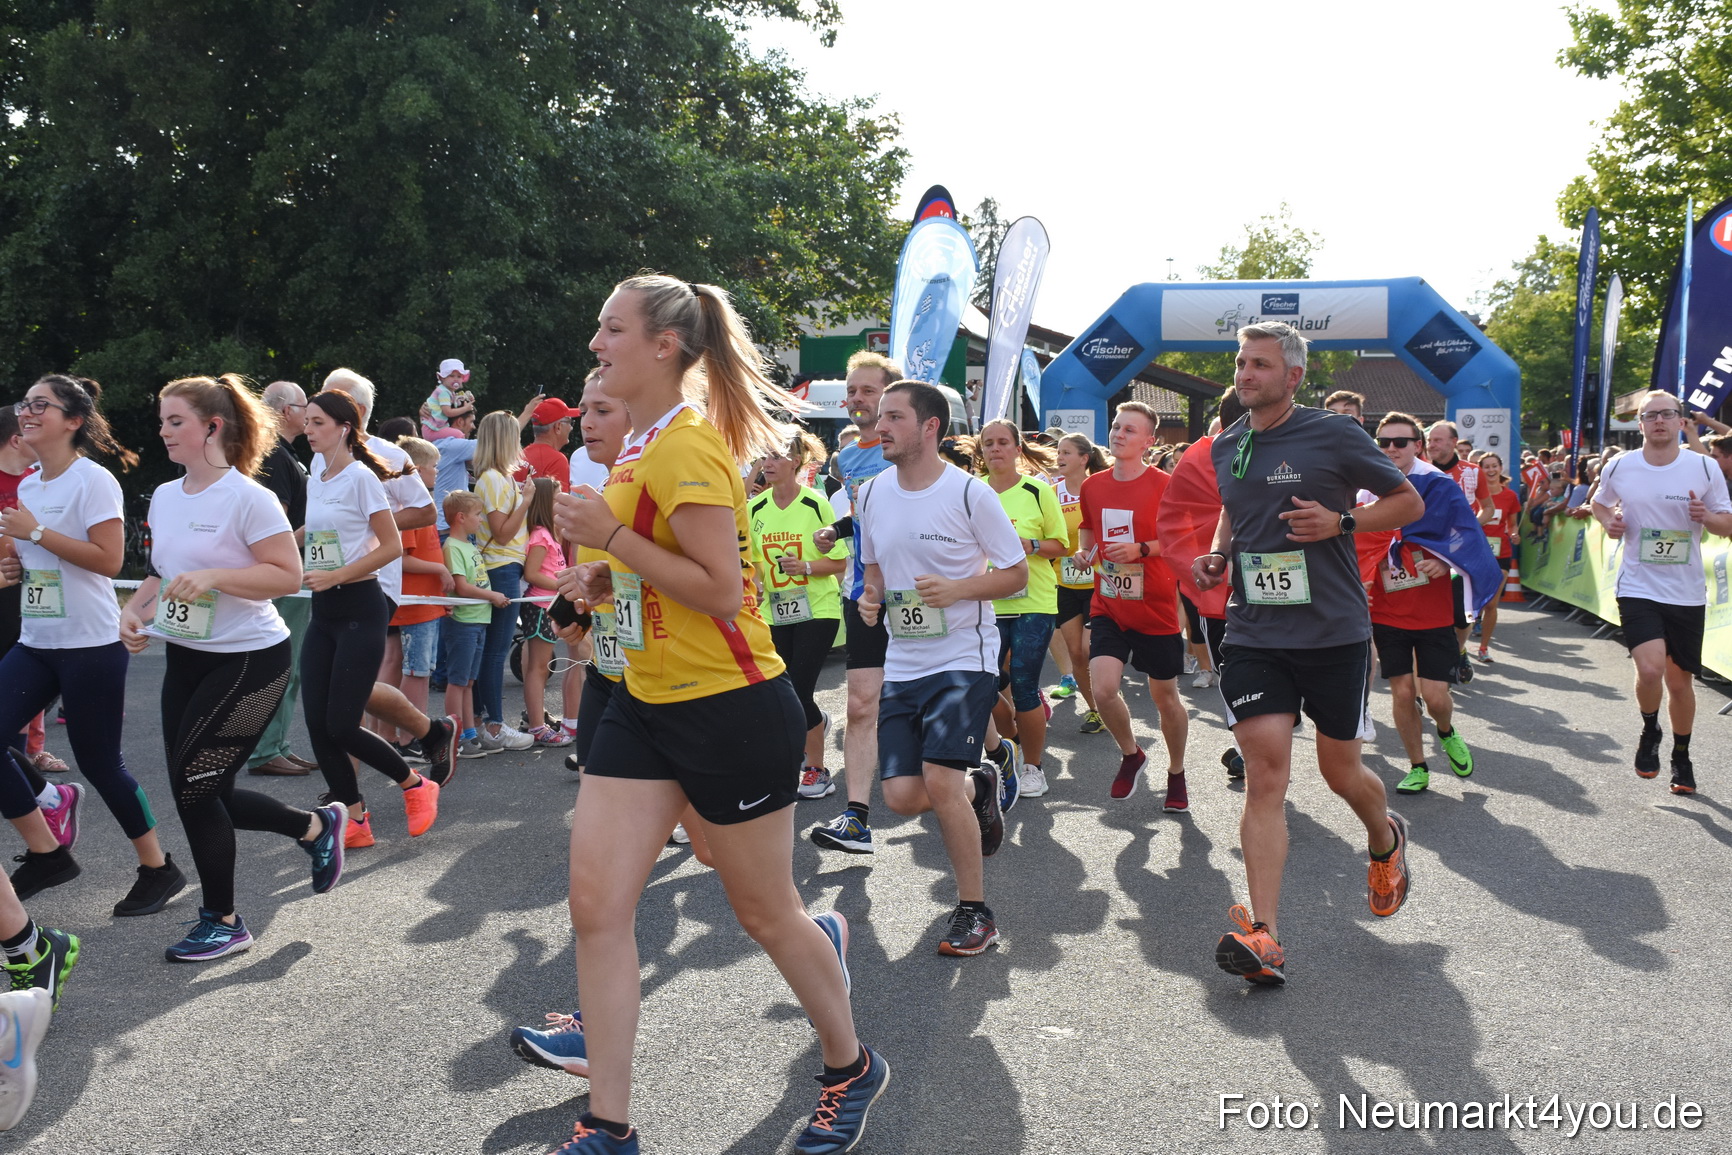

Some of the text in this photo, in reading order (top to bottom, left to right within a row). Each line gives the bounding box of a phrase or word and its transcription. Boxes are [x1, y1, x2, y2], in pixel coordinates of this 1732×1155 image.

[1008, 236, 1033, 312] Fischer
[1268, 300, 1297, 309] Fischer
[1090, 344, 1134, 354] Fischer
[1266, 473, 1302, 481] BURKHARDT
[1665, 494, 1692, 502] auctore
[761, 531, 803, 544] Müller
[919, 533, 958, 543] auctores
[311, 545, 325, 560] 91
[1655, 541, 1675, 555] 37
[1065, 565, 1092, 577] 170
[1255, 571, 1292, 591] 415
[27, 586, 43, 605] 87
[166, 601, 189, 623] 93
[776, 600, 800, 616] 672
[901, 606, 923, 626] 36
[1231, 692, 1264, 708] saller
[186, 770, 219, 783] GYMSHARK
